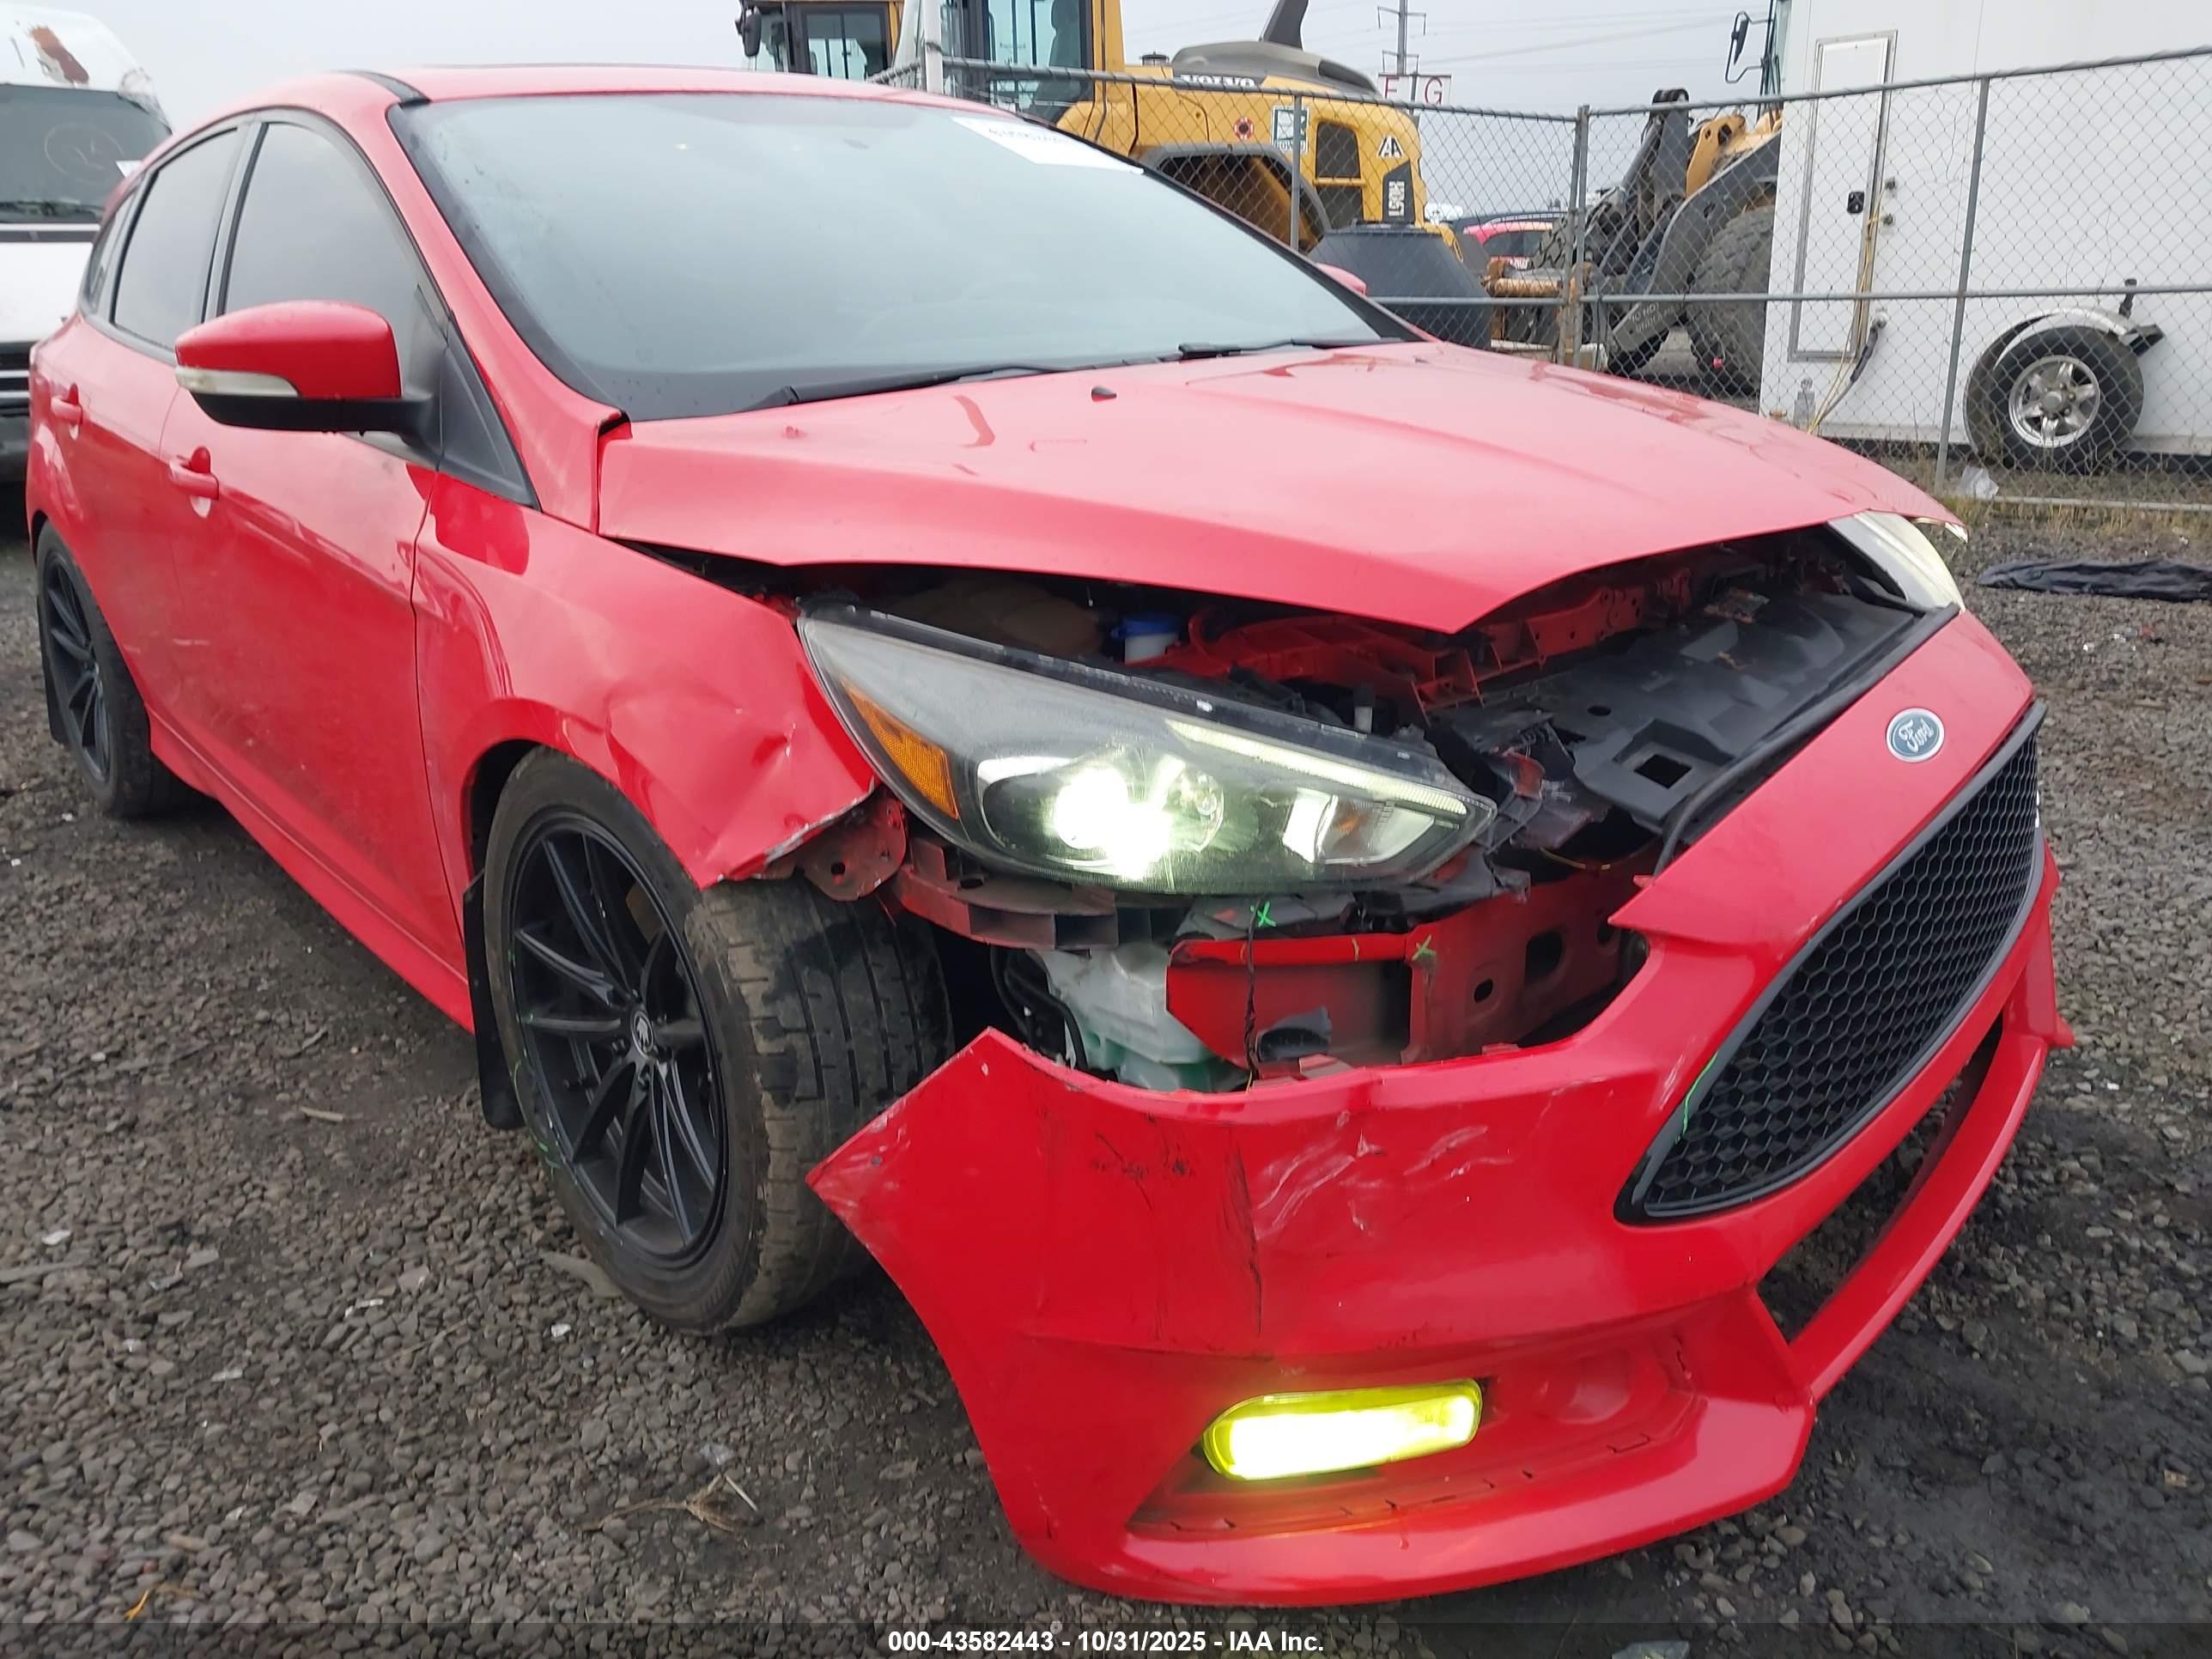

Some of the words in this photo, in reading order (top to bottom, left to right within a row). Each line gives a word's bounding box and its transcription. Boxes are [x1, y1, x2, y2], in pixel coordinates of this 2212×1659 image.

[1180, 75, 1255, 88] VOLVO
[1385, 75, 1400, 100] F
[1425, 76, 1443, 105] G
[1898, 718, 1934, 753] Ford
